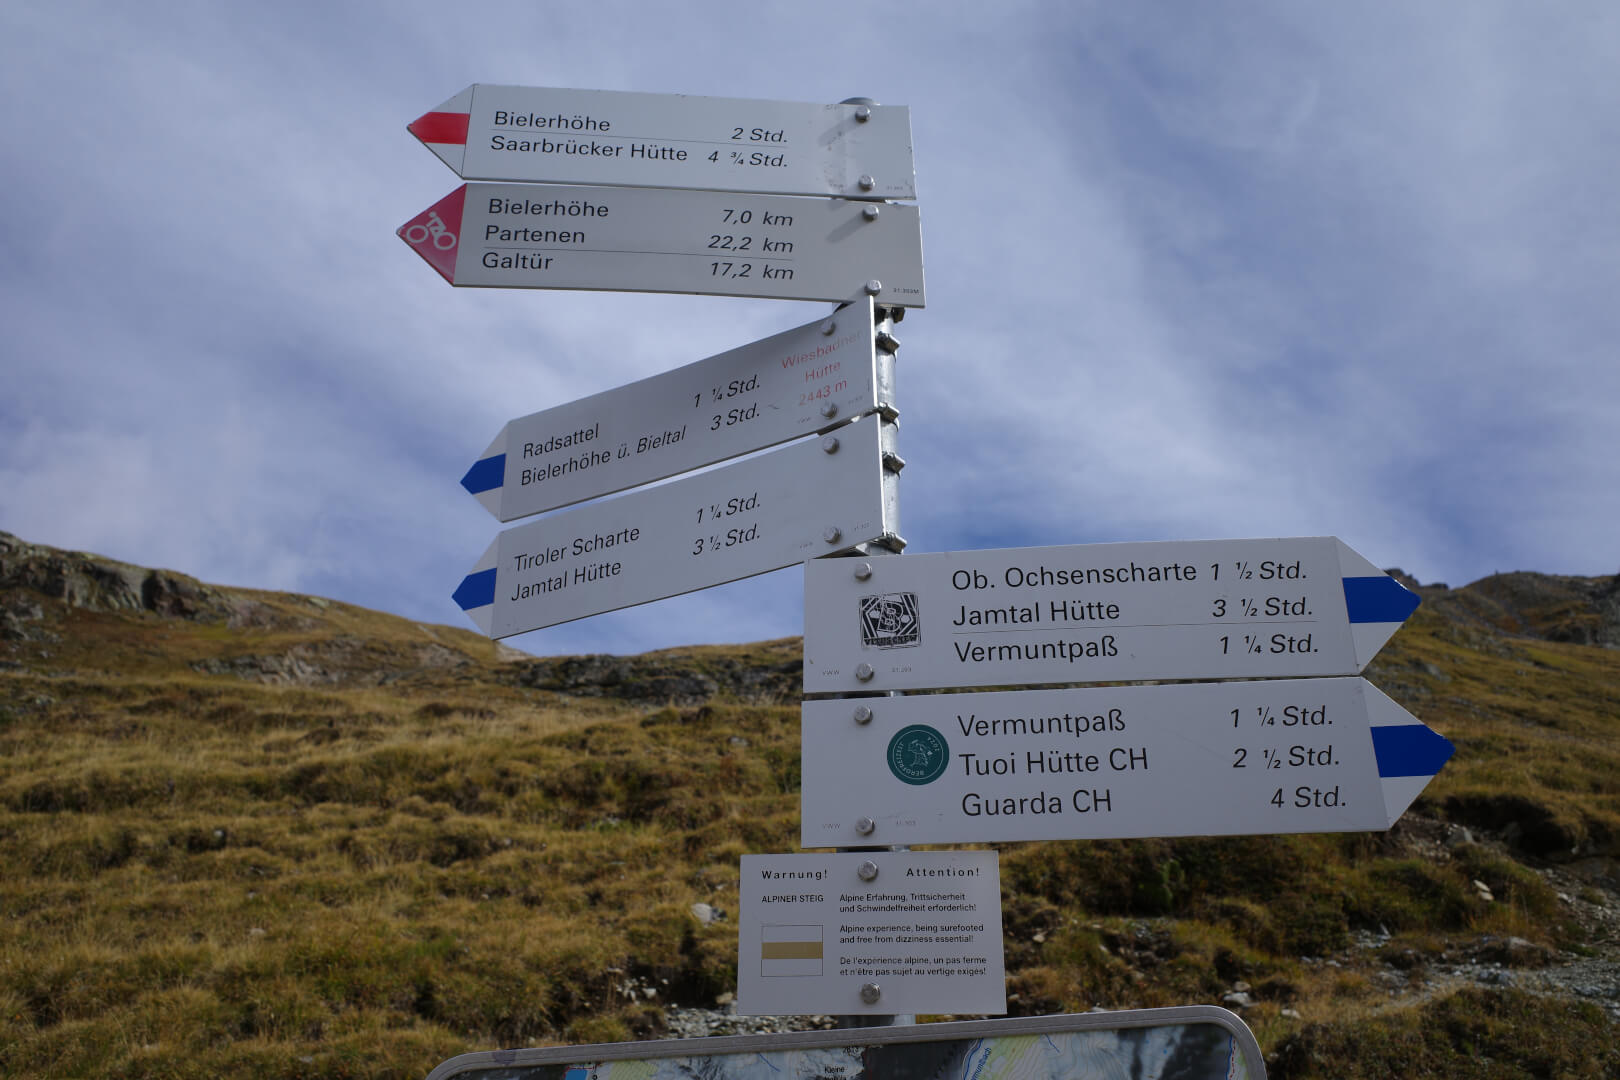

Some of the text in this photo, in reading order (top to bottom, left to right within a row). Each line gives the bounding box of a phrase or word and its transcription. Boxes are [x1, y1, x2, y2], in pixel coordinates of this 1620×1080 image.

[494, 111, 610, 132] Bielerhöhe
[731, 127, 788, 143] 2 Std.
[490, 135, 688, 161] Saarbrücker Hütte
[707, 150, 719, 163] 4
[749, 152, 788, 168] Std.
[488, 198, 609, 218] Bielerhöhe
[723, 209, 793, 227] 7,0 km
[484, 223, 585, 244] Partenen
[707, 234, 794, 253] 22,2 km
[481, 251, 554, 270] Galtür
[711, 262, 794, 280] 17,2 km
[694, 393, 701, 409] 1
[726, 373, 760, 398] Std.
[799, 385, 832, 406] 2443
[835, 379, 848, 393] m
[710, 401, 760, 431] 3 Std.
[523, 422, 599, 460] Radsattel
[521, 424, 687, 486] Bielerhöhe ü. Bieltal
[697, 508, 704, 524] 1
[726, 491, 761, 516] Std.
[514, 528, 640, 572] Tiroler Scharte
[692, 538, 705, 556] 3
[725, 522, 760, 547] Std.
[511, 562, 622, 602] Jamtal Hütte
[952, 561, 1198, 591] Ob. Ochsenscharte
[1210, 563, 1220, 582] 1
[1258, 560, 1307, 581] Std.
[952, 600, 1120, 627] Jamtal Hütte
[1211, 599, 1227, 618] 3
[1264, 596, 1313, 617] Std.
[954, 635, 1119, 664] Vermuntpaß
[1220, 636, 1229, 655] 1
[1270, 633, 1319, 654] Std.
[957, 708, 1126, 738] Vermuntpaß
[1230, 708, 1240, 729] 1
[1282, 704, 1334, 727] Std.
[958, 747, 1149, 776] Tuoi Hütte CH
[1233, 747, 1248, 769] 2
[1288, 744, 1340, 768] Std.
[961, 788, 1112, 817] Guarda CH
[1270, 785, 1347, 809] 4 Std.
[761, 868, 828, 881] Warnung!
[906, 866, 980, 878] Attention!
[762, 894, 824, 903] ALPINER STEIG
[840, 894, 865, 903] Alpine
[911, 892, 966, 901] Trittsicherheit
[840, 904, 855, 912] und
[856, 903, 926, 912] Schwindelfreiheit
[840, 924, 865, 934] Alpine
[915, 923, 938, 934] being
[940, 923, 984, 932] surefooted
[840, 935, 855, 944] and
[857, 935, 873, 943] free
[874, 935, 894, 943] from
[895, 935, 933, 943] dizziness
[840, 956, 851, 965] De
[945, 956, 961, 966] pas
[962, 955, 987, 964] ferme
[840, 968, 848, 976] et
[875, 968, 891, 977] pas
[892, 967, 912, 977] sujet
[926, 967, 956, 977] vertige
